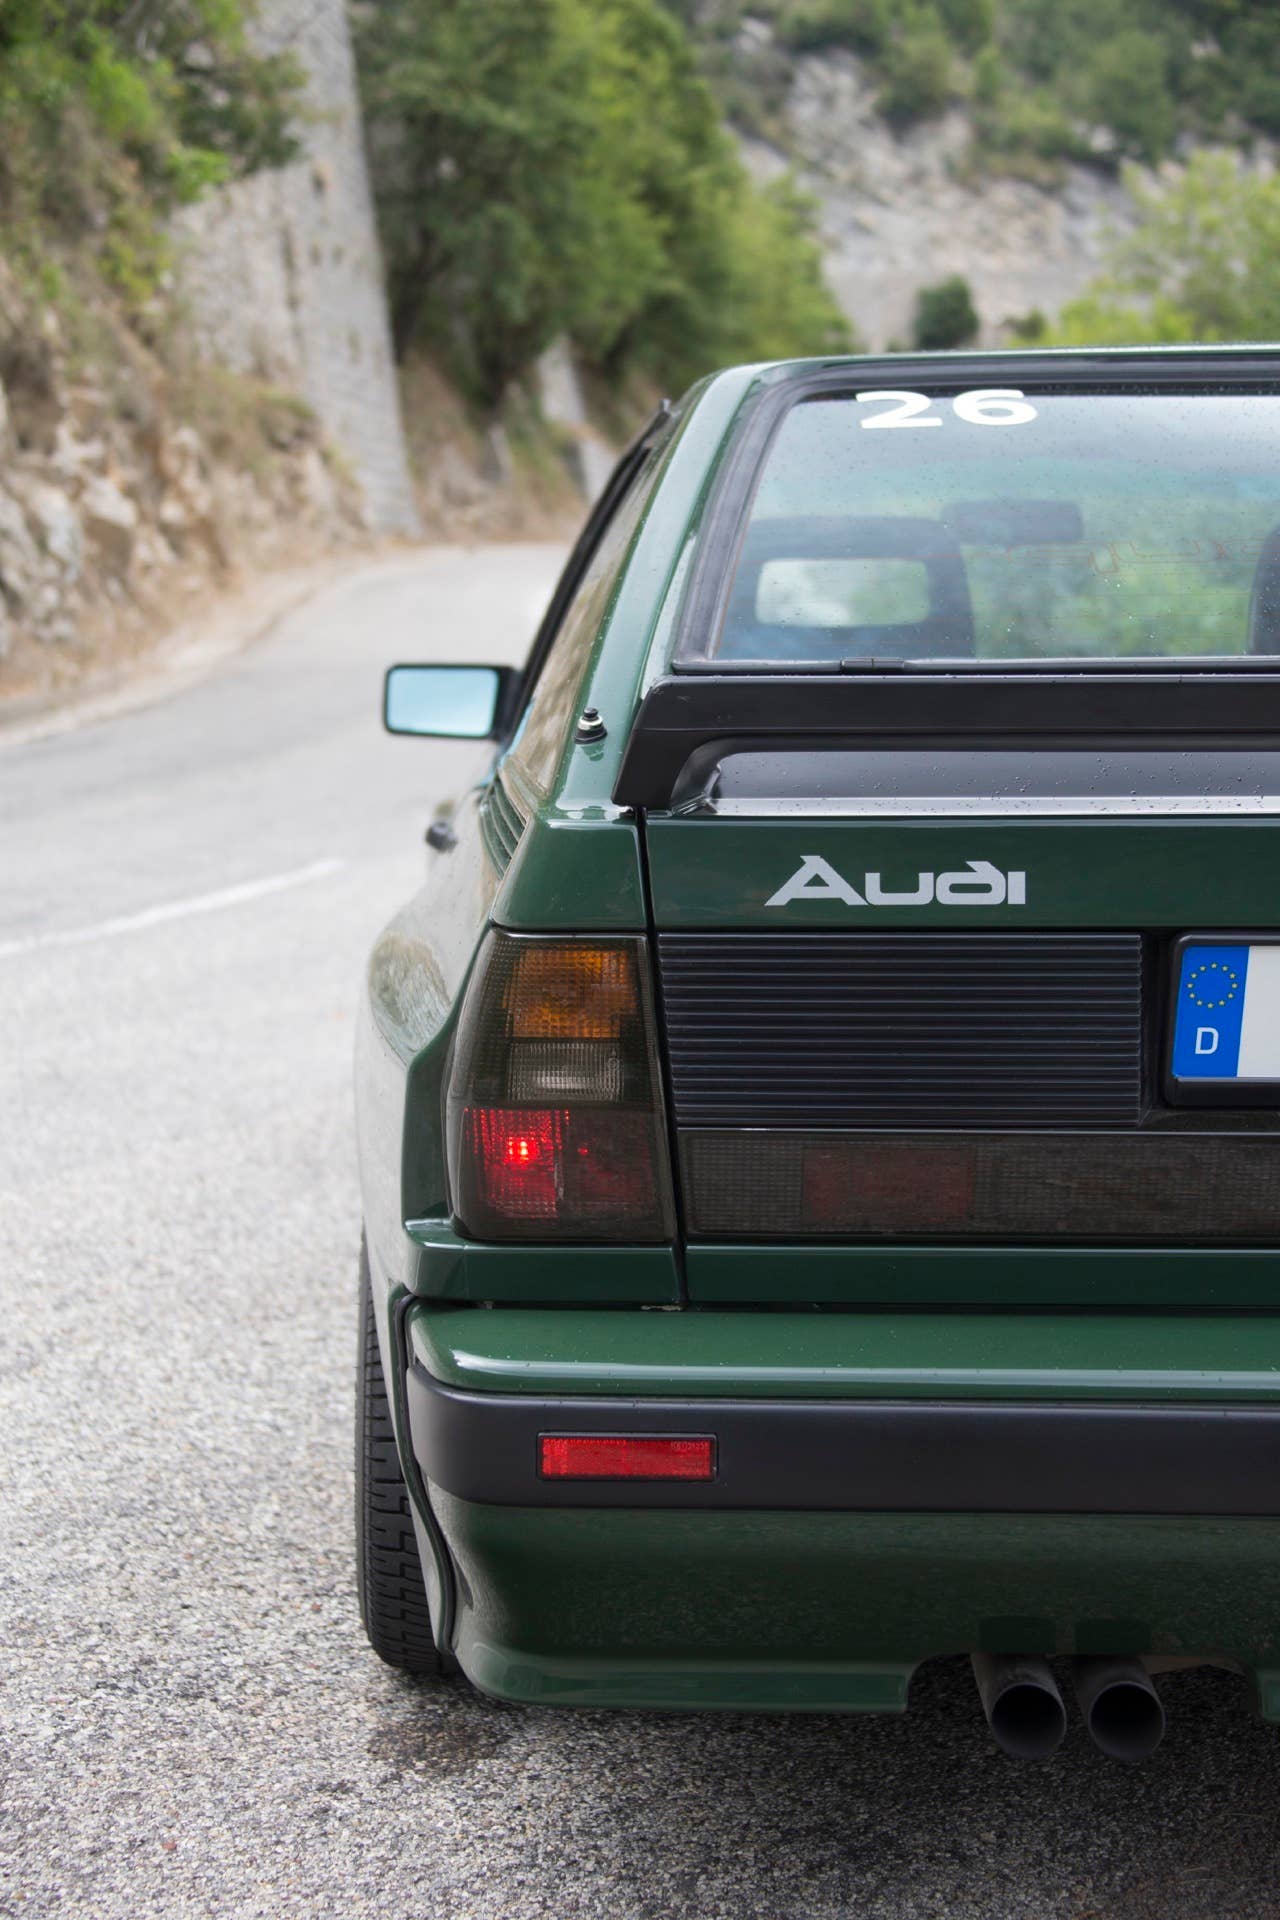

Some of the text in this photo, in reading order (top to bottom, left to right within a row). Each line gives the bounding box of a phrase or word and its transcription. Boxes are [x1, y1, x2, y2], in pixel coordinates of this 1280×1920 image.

[856, 389, 1038, 429] 26
[764, 855, 1026, 907] Audi
[1195, 1027, 1219, 1055] D
